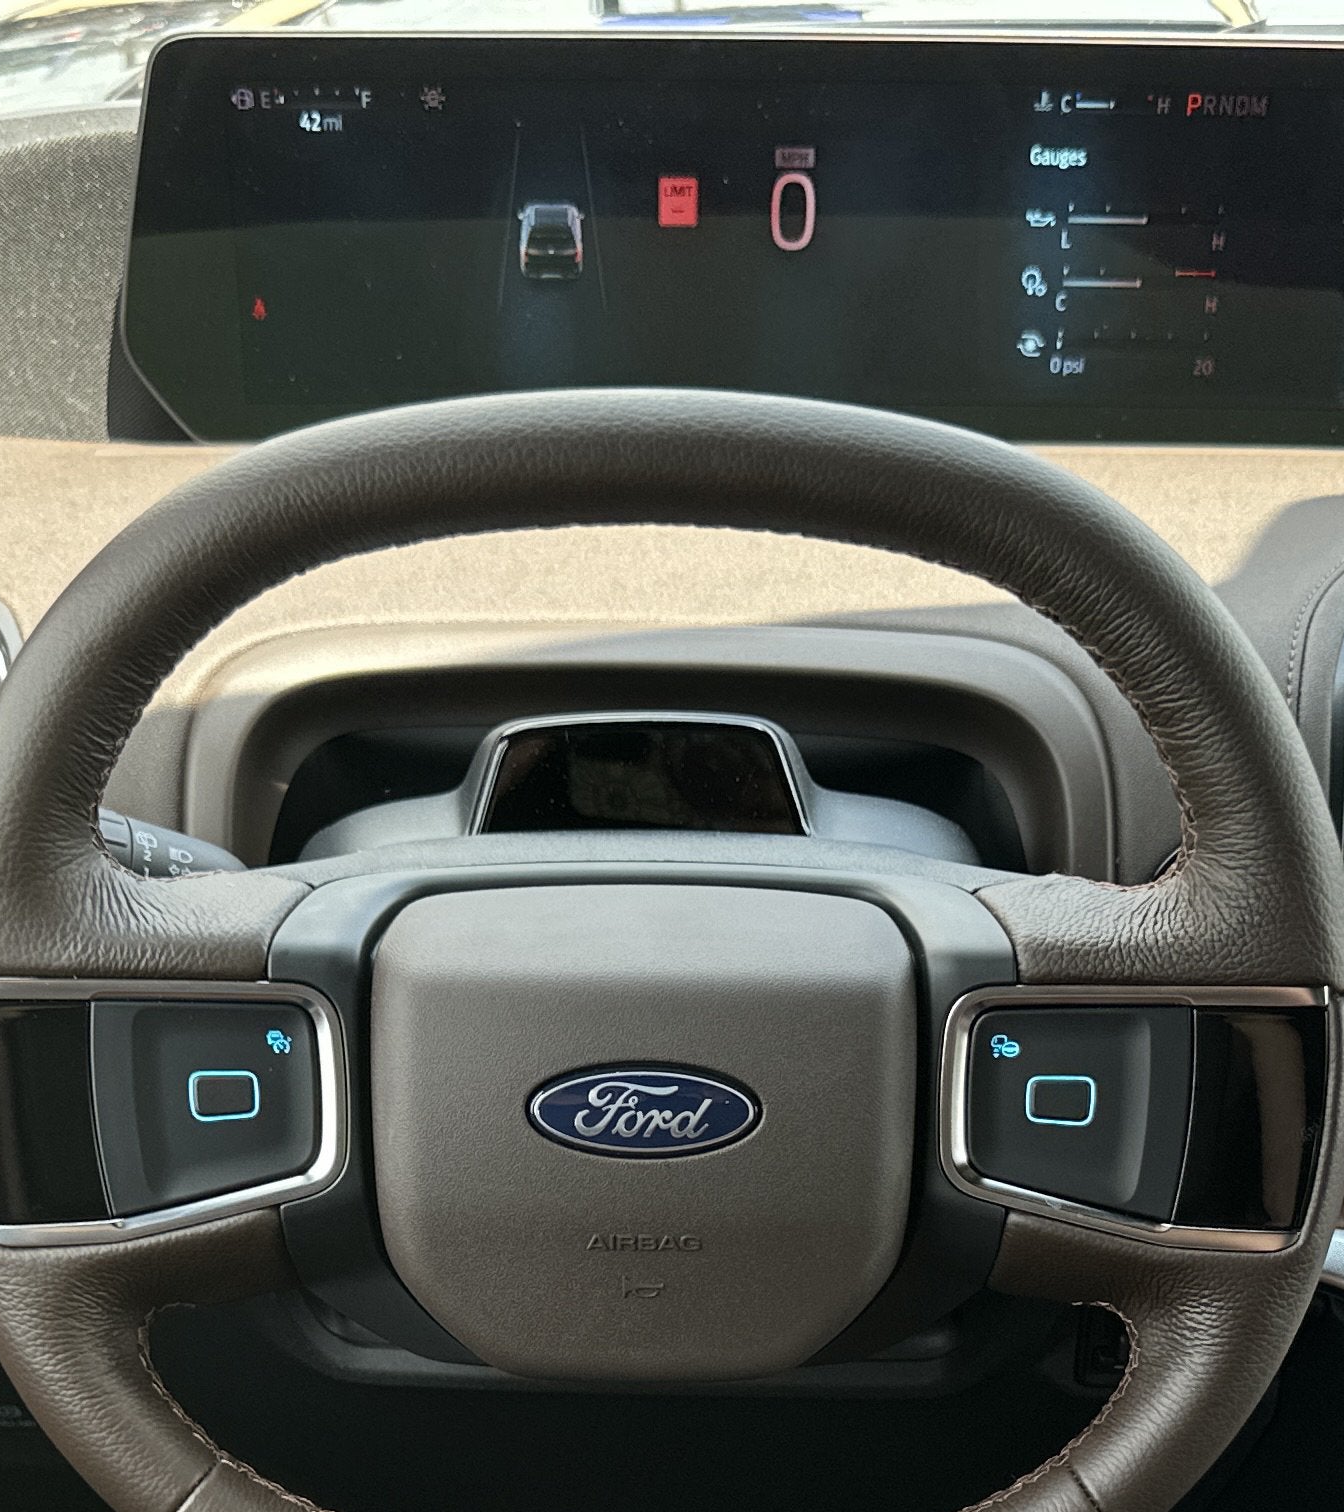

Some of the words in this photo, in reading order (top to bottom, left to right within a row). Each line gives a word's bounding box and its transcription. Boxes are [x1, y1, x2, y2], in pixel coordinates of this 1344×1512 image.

[361, 91, 372, 108] F
[1029, 144, 1088, 170] Gauges
[770, 172, 817, 253] 0
[573, 1081, 713, 1139] Ford
[585, 1233, 703, 1252] AIRBAG
